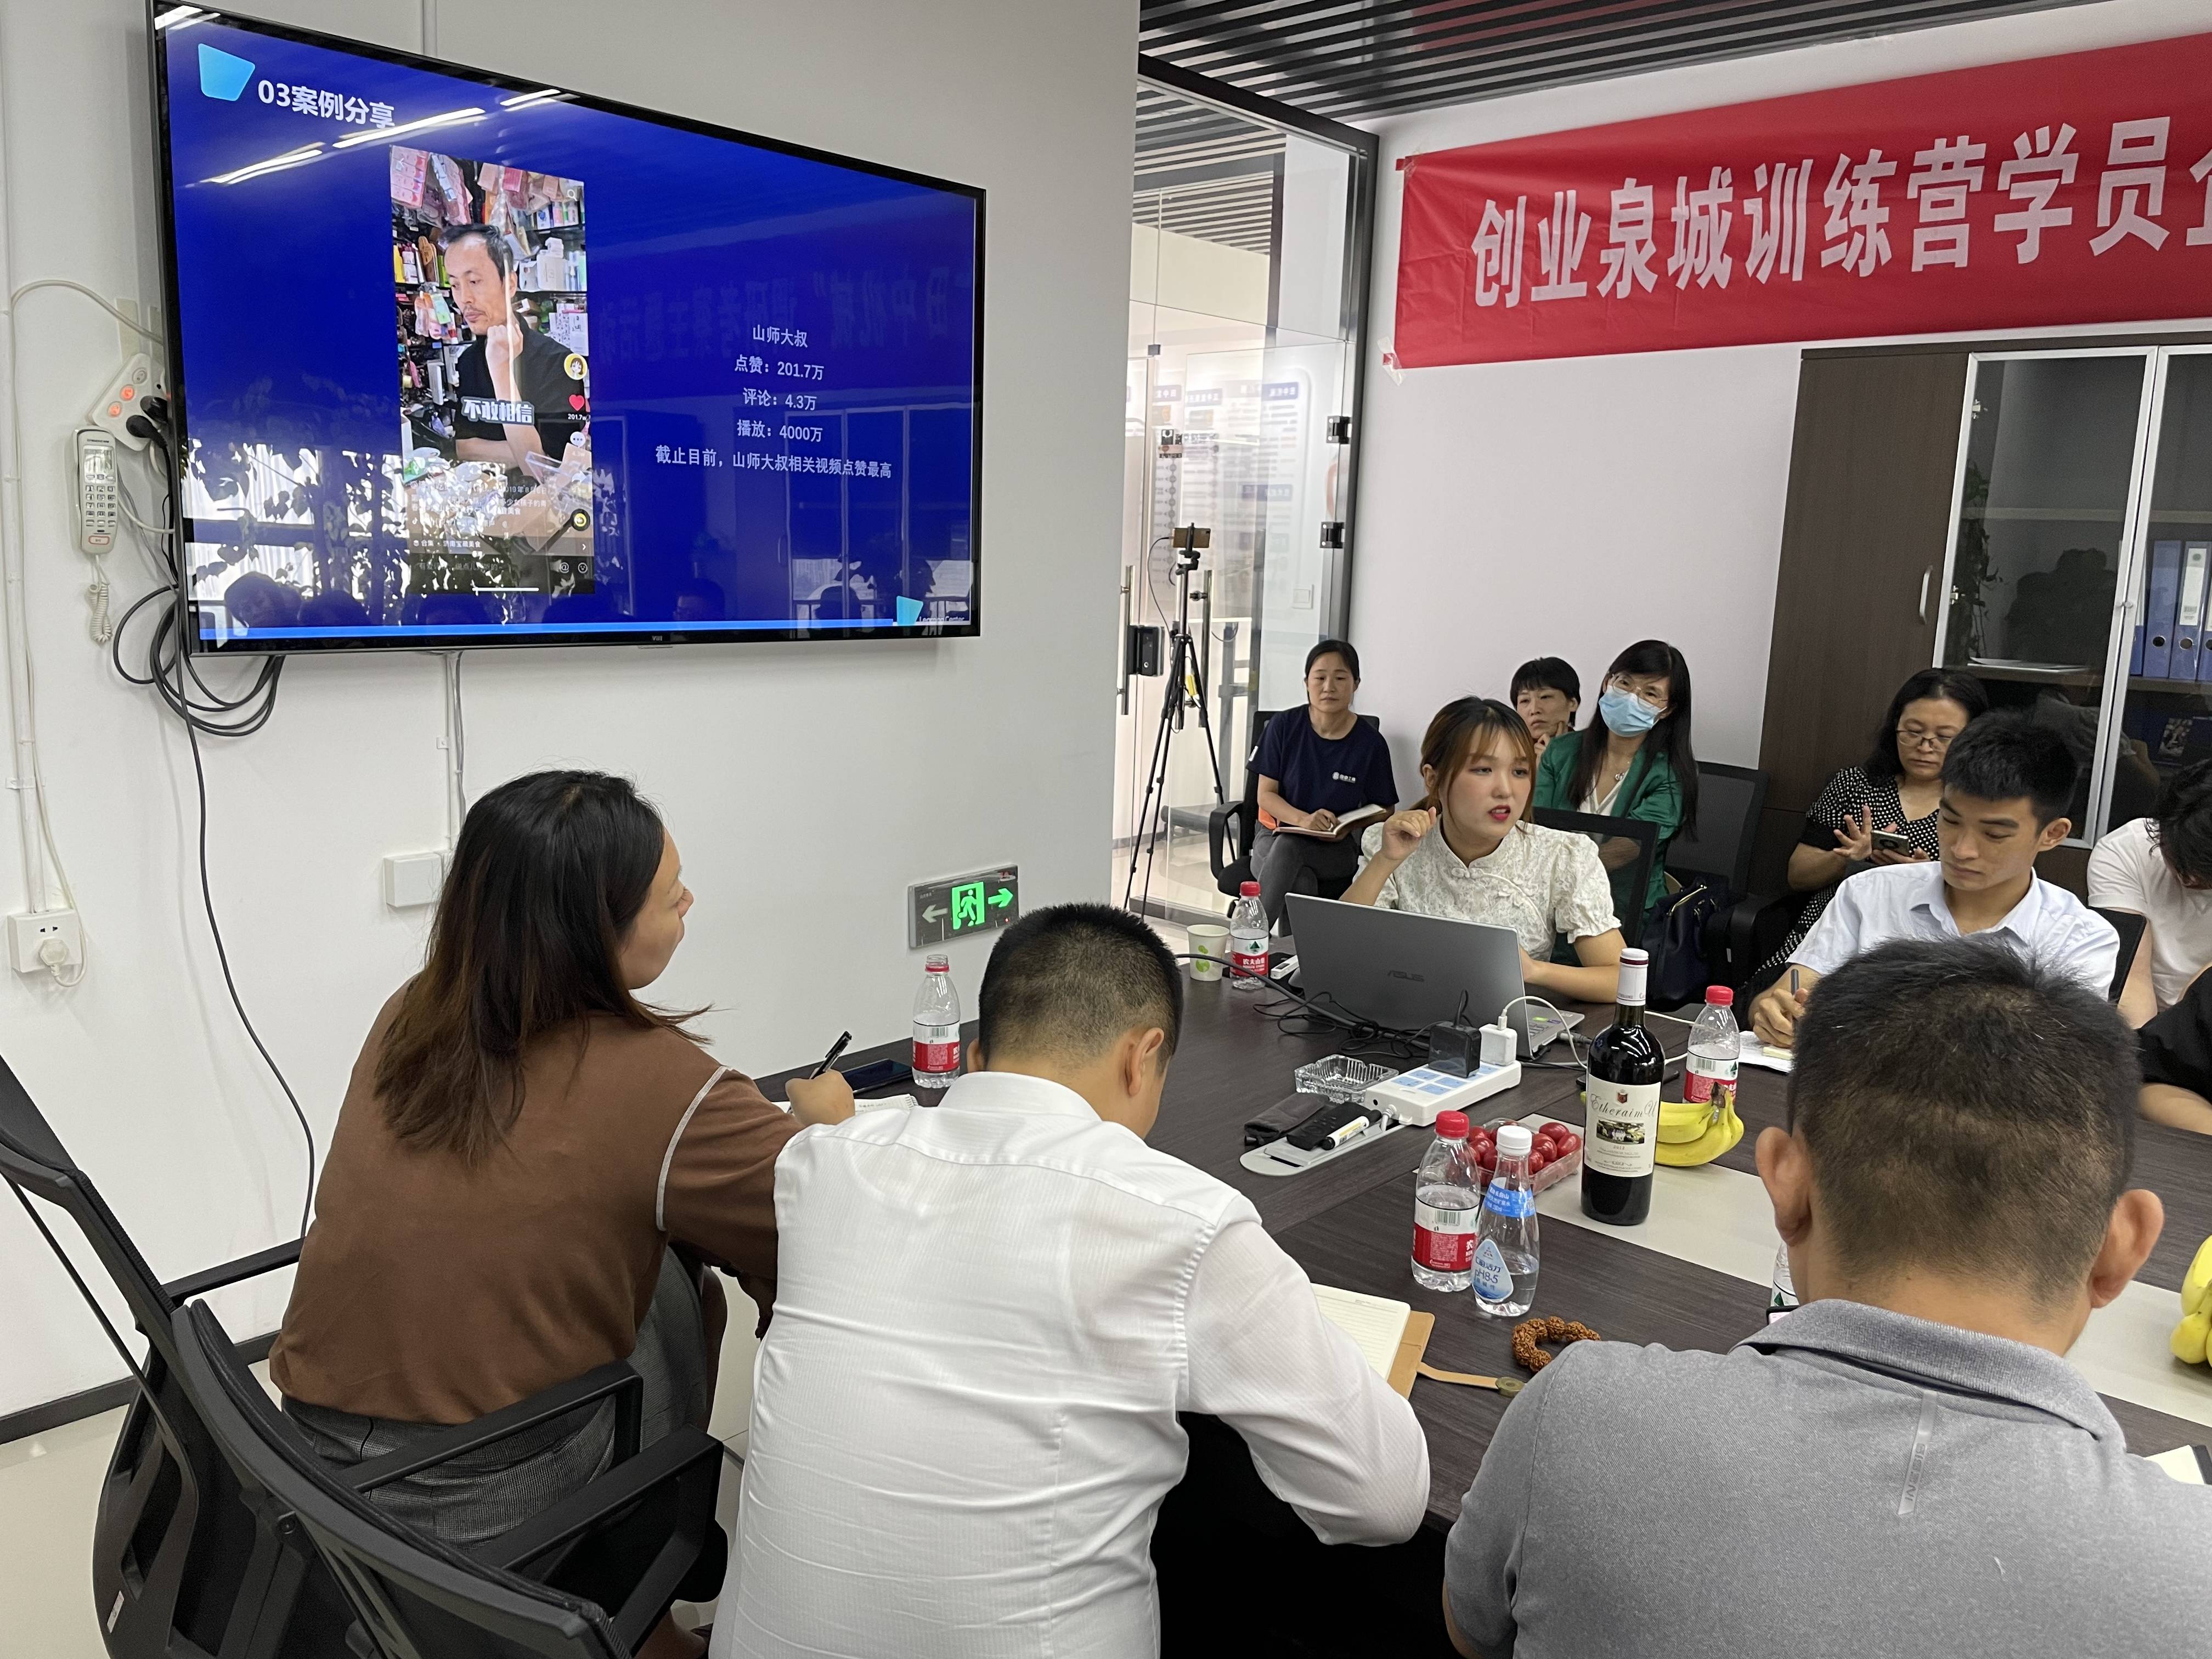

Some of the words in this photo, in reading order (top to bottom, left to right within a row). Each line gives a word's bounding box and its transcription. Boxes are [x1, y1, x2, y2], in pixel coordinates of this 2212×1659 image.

[258, 80, 395, 128] 03案例分享
[753, 325, 808, 348] 山师大叔
[464, 399, 533, 424] 不敢相信
[656, 445, 892, 479] 截止目前，山师大叔相关视频点赞最高
[1387, 969, 1425, 983] ASUS
